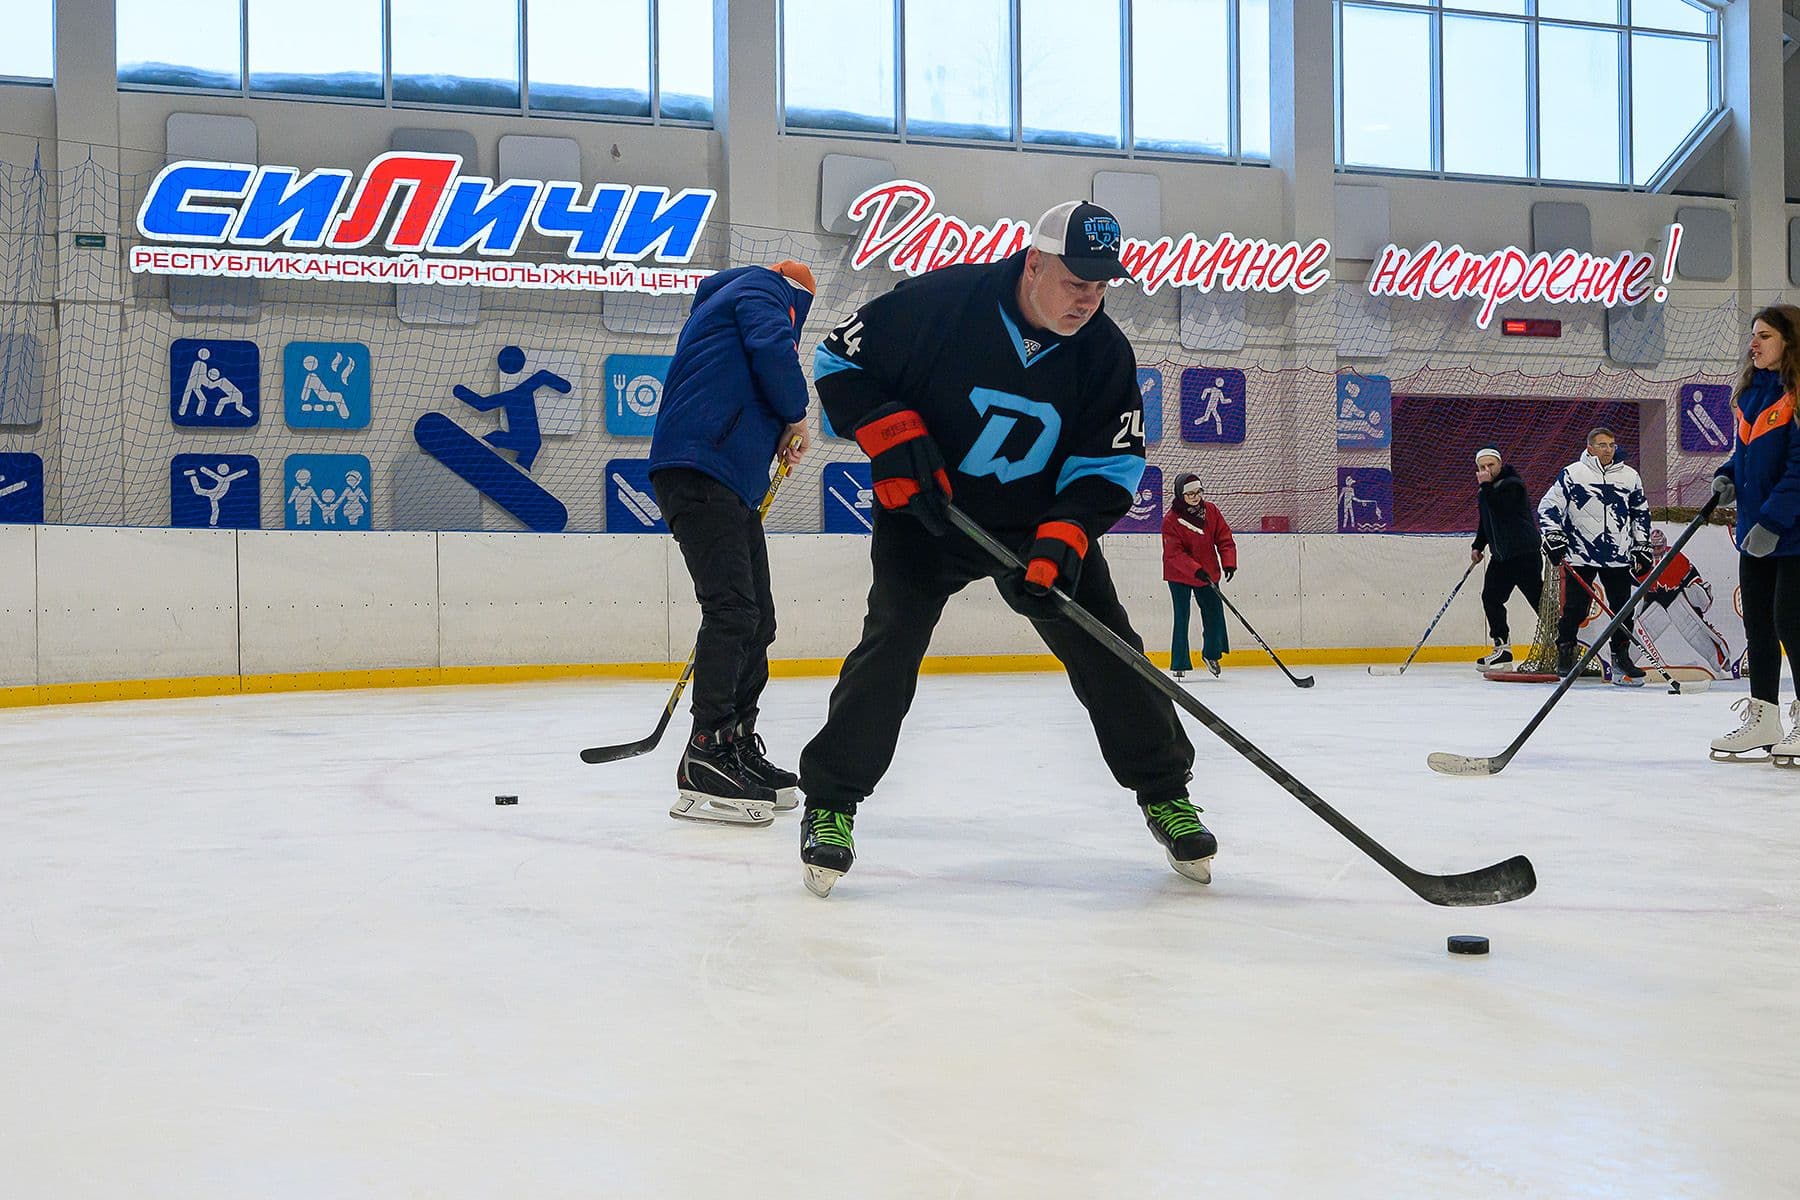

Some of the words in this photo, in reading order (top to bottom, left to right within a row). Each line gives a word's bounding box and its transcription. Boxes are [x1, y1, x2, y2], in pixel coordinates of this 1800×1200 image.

[135, 252, 420, 278] РЕСПУБЛИКАНСКИЙ
[427, 263, 634, 287] ГОРНОЛЫЖНЫЙ
[641, 272, 711, 292] ЦЕНТ
[1112, 237, 1327, 291] тличное
[1111, 409, 1146, 449] 24
[1641, 633, 1661, 663] CANADA
